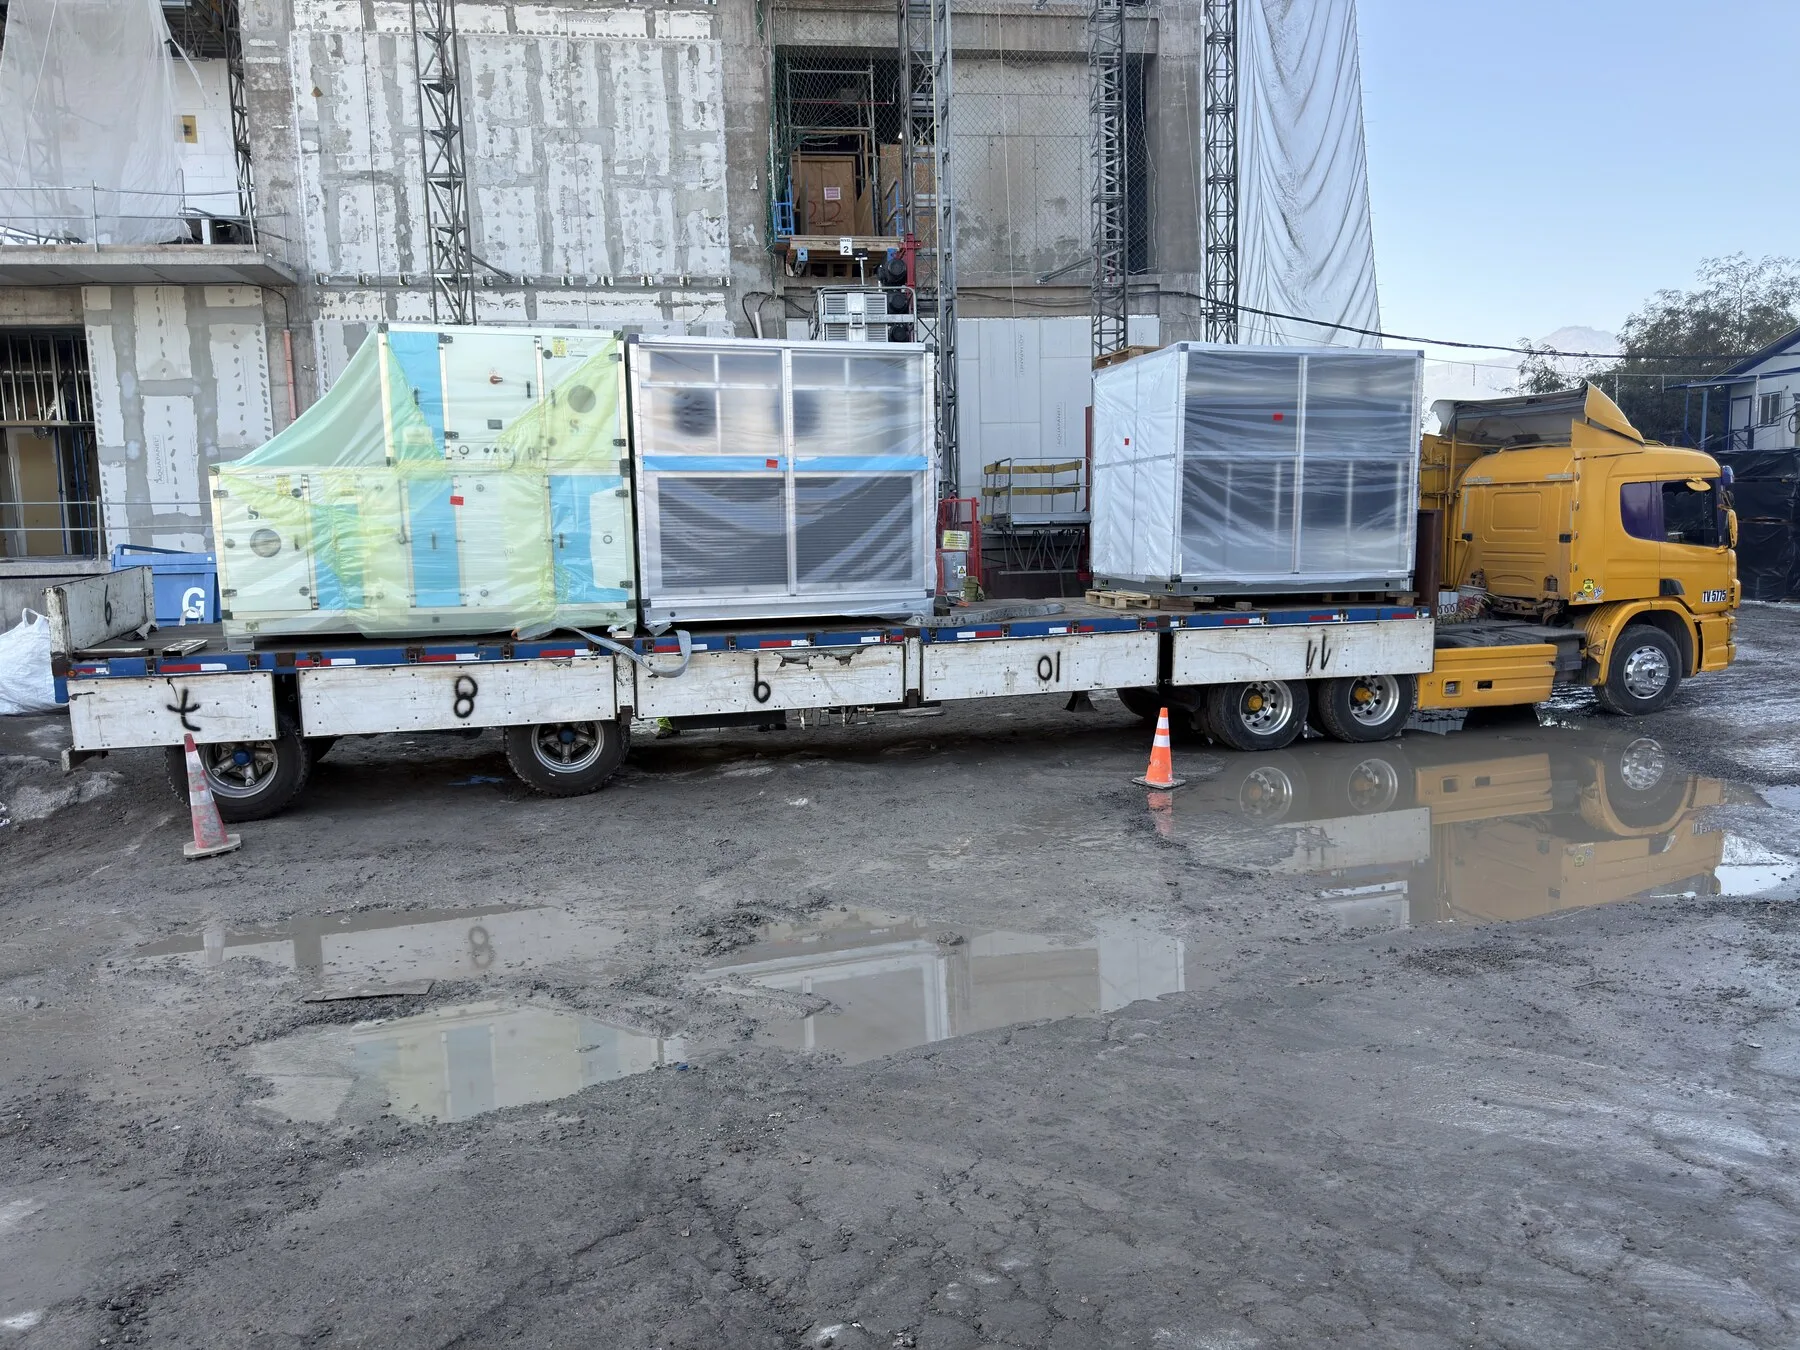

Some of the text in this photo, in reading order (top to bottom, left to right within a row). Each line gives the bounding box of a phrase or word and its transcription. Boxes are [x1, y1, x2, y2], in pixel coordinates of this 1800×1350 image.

[843, 245, 849, 254] 2
[104, 584, 112, 627] 6
[182, 587, 205, 619] G
[453, 674, 479, 719] 8
